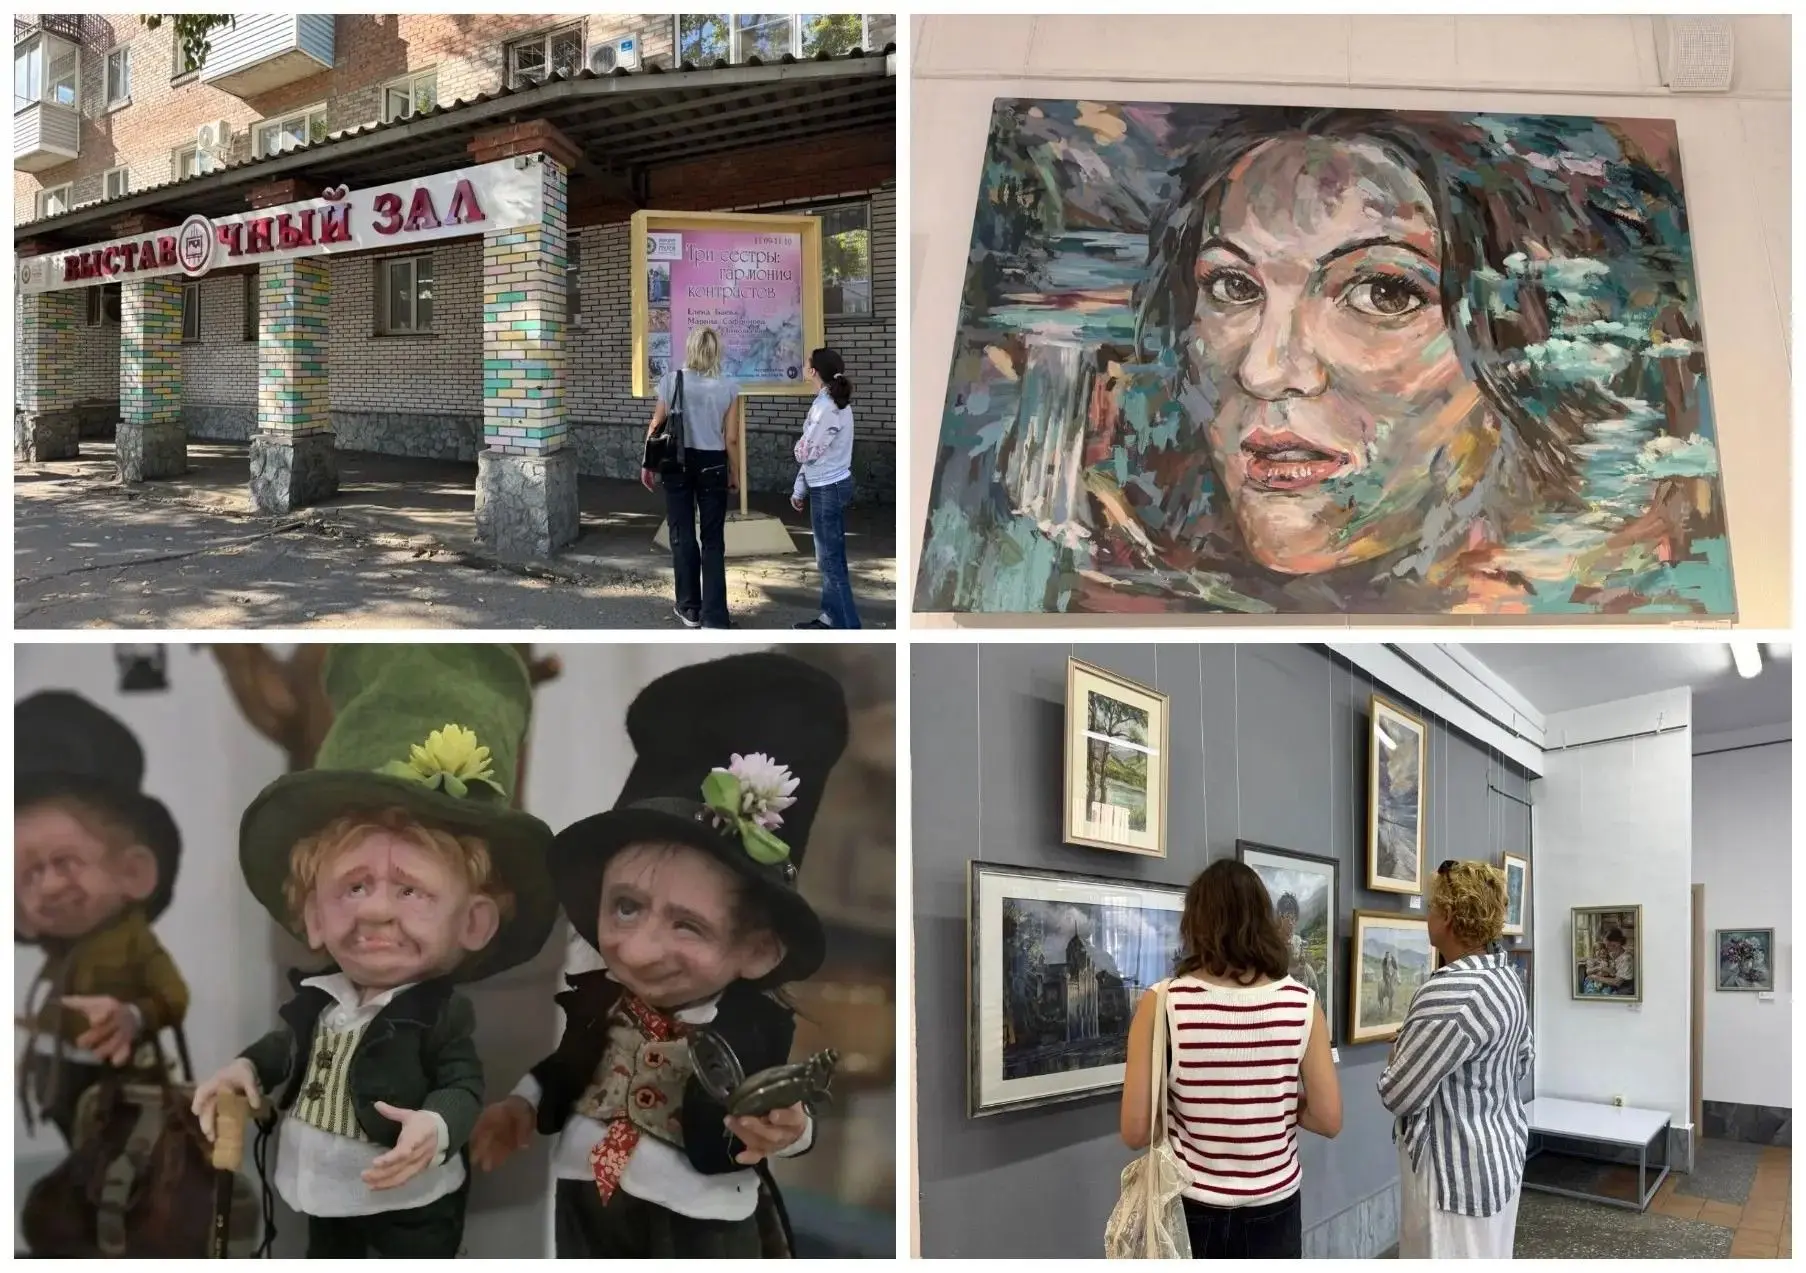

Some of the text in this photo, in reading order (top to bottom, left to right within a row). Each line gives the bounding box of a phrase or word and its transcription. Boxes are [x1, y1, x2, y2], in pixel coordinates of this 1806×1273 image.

[372, 178, 486, 235] ЗАЛ
[686, 243, 715, 267] Три
[720, 250, 781, 269] сестры:
[719, 268, 792, 286] гармония
[687, 285, 776, 304] контрастов
[687, 307, 711, 316] Елена
[687, 317, 718, 325] Марина
